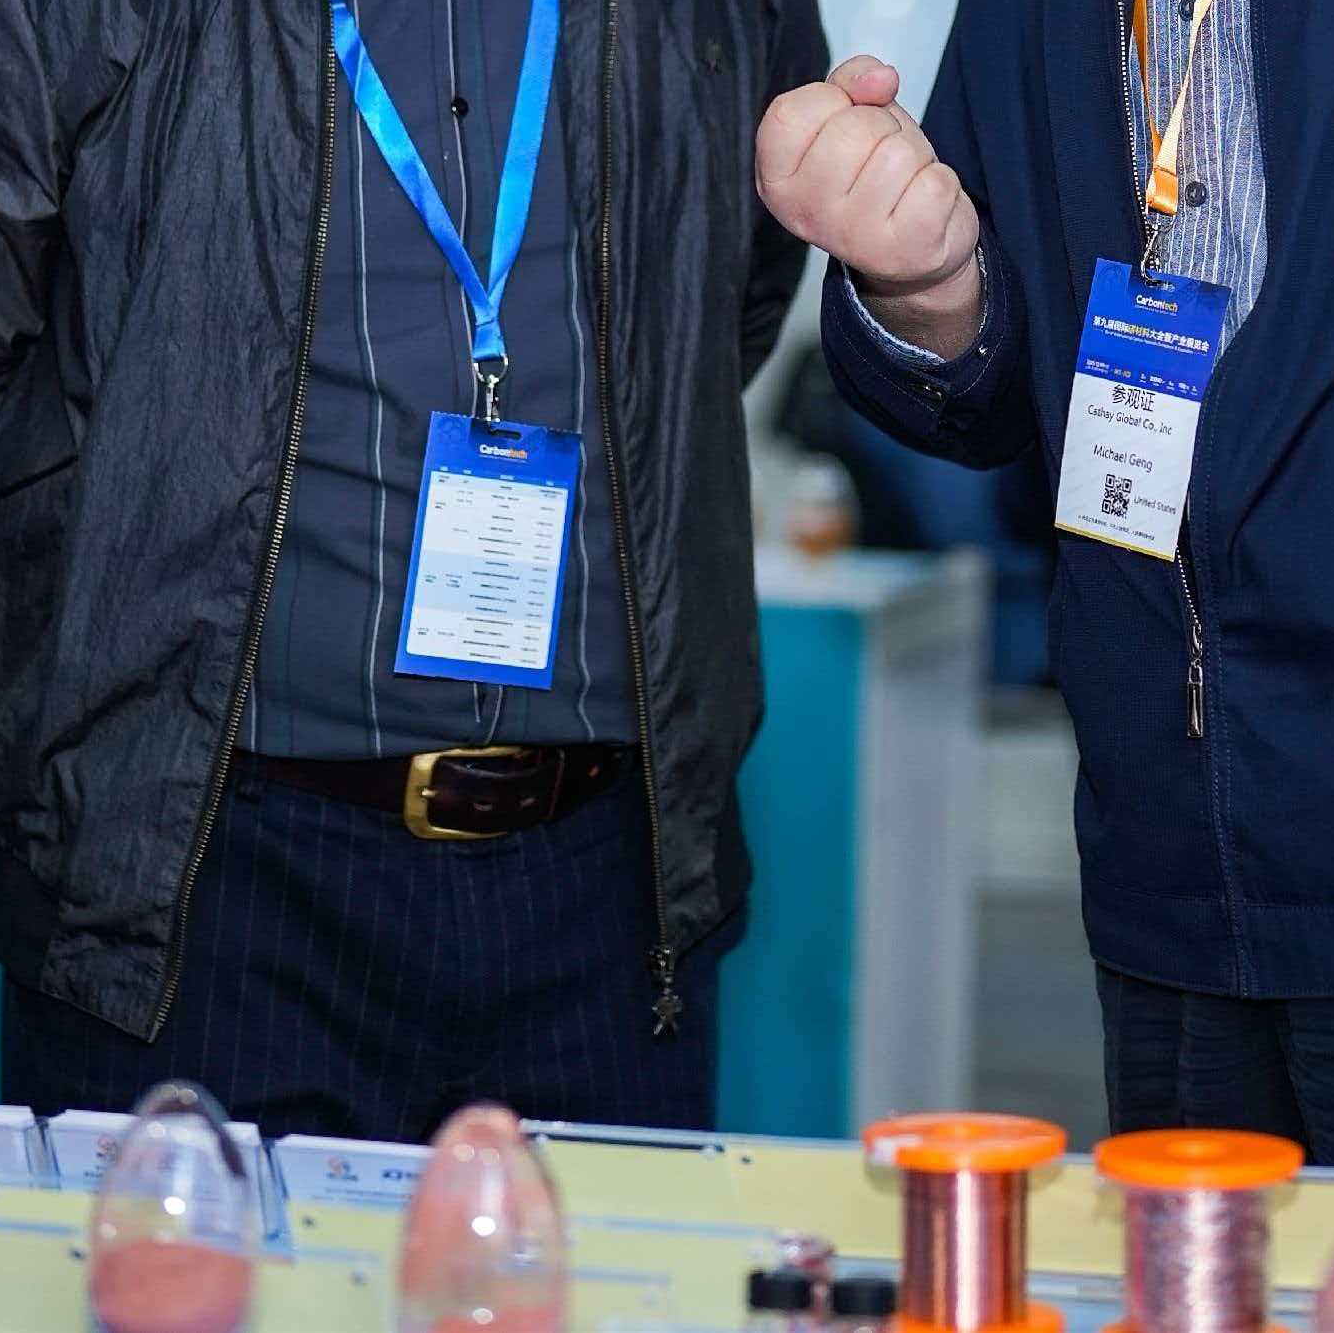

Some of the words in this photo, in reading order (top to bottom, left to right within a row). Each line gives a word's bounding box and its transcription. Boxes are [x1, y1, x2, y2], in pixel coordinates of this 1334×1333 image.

[1136, 294, 1178, 313] Carbontech
[1112, 385, 1155, 412] 参观证
[1093, 444, 1127, 463] Michael
[1129, 453, 1153, 473] Geng
[1134, 495, 1158, 510] United
[1158, 499, 1176, 515] States
